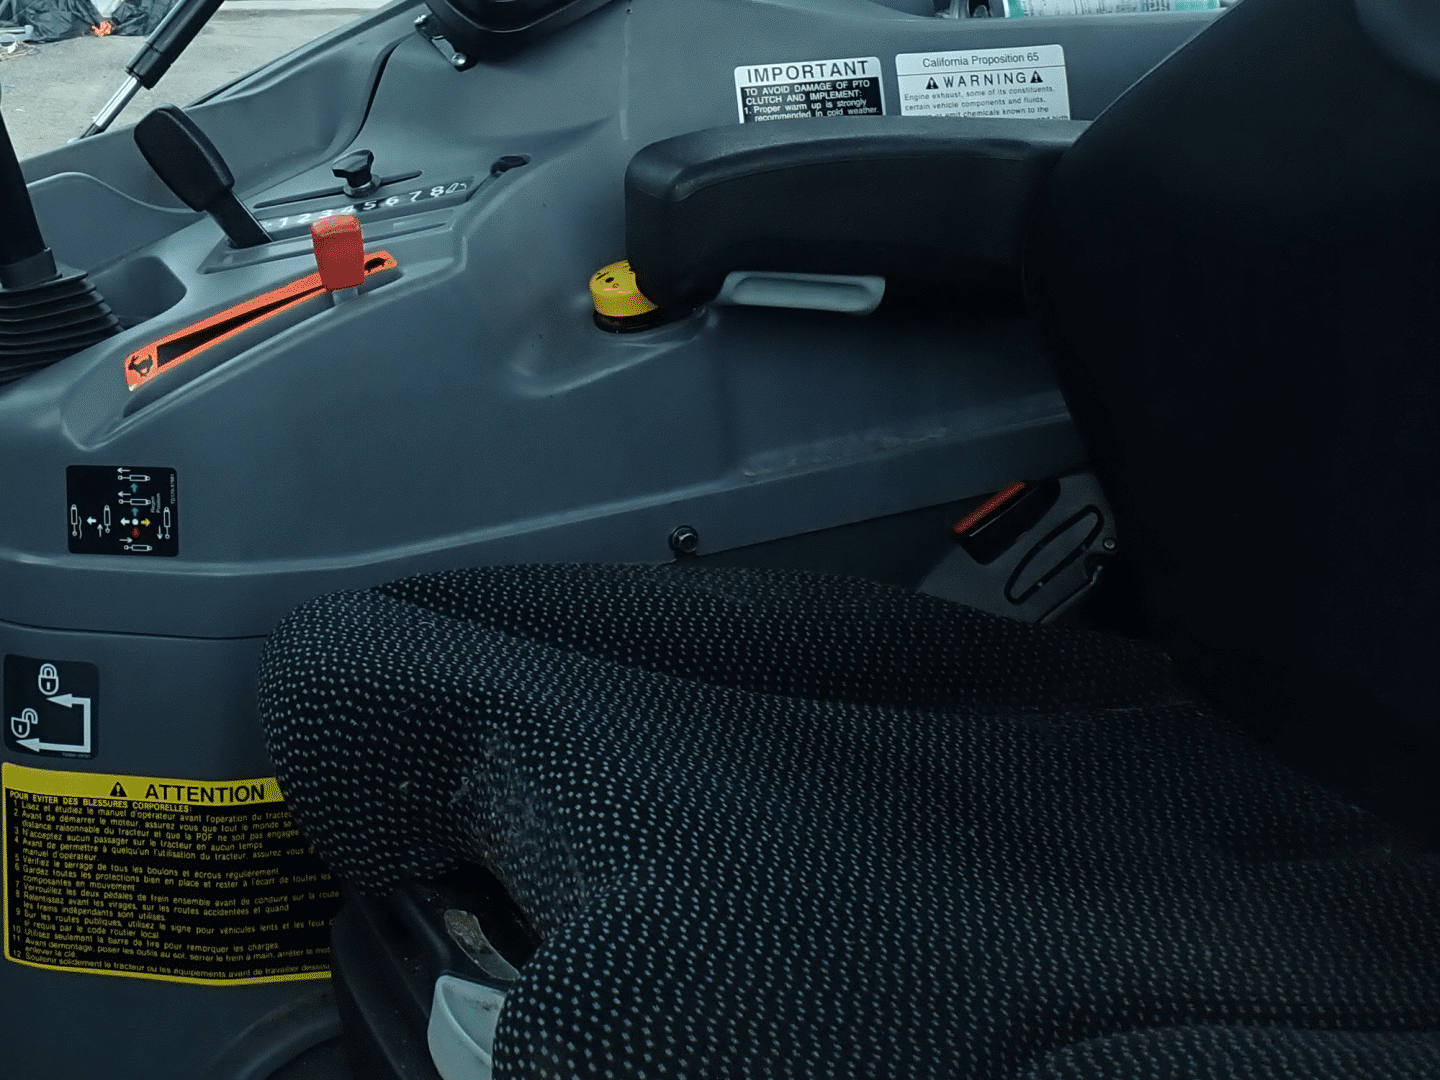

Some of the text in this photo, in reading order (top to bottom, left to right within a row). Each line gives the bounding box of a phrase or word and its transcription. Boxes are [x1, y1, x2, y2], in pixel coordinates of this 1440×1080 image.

[923, 52, 1039, 67] California Proposition 65
[748, 60, 868, 82] IMPORTANT
[943, 72, 1026, 88] WARNING
[762, 86, 789, 94] AVOID
[794, 82, 832, 92] DAMAGE
[746, 90, 862, 105] CLUTCH AND IMPLEMENT:
[961, 99, 1005, 108] components
[754, 105, 780, 114] Proper
[837, 98, 866, 107] strongly
[827, 108, 843, 116] cold
[963, 109, 1000, 117] chemicals
[363, 200, 377, 210] 5
[385, 196, 399, 206] 6
[408, 190, 422, 202] 7
[430, 186, 444, 198] 8
[10, 791, 28, 801] POUR
[83, 800, 128, 808] BLESSURES
[145, 784, 265, 803] ATTENTION
